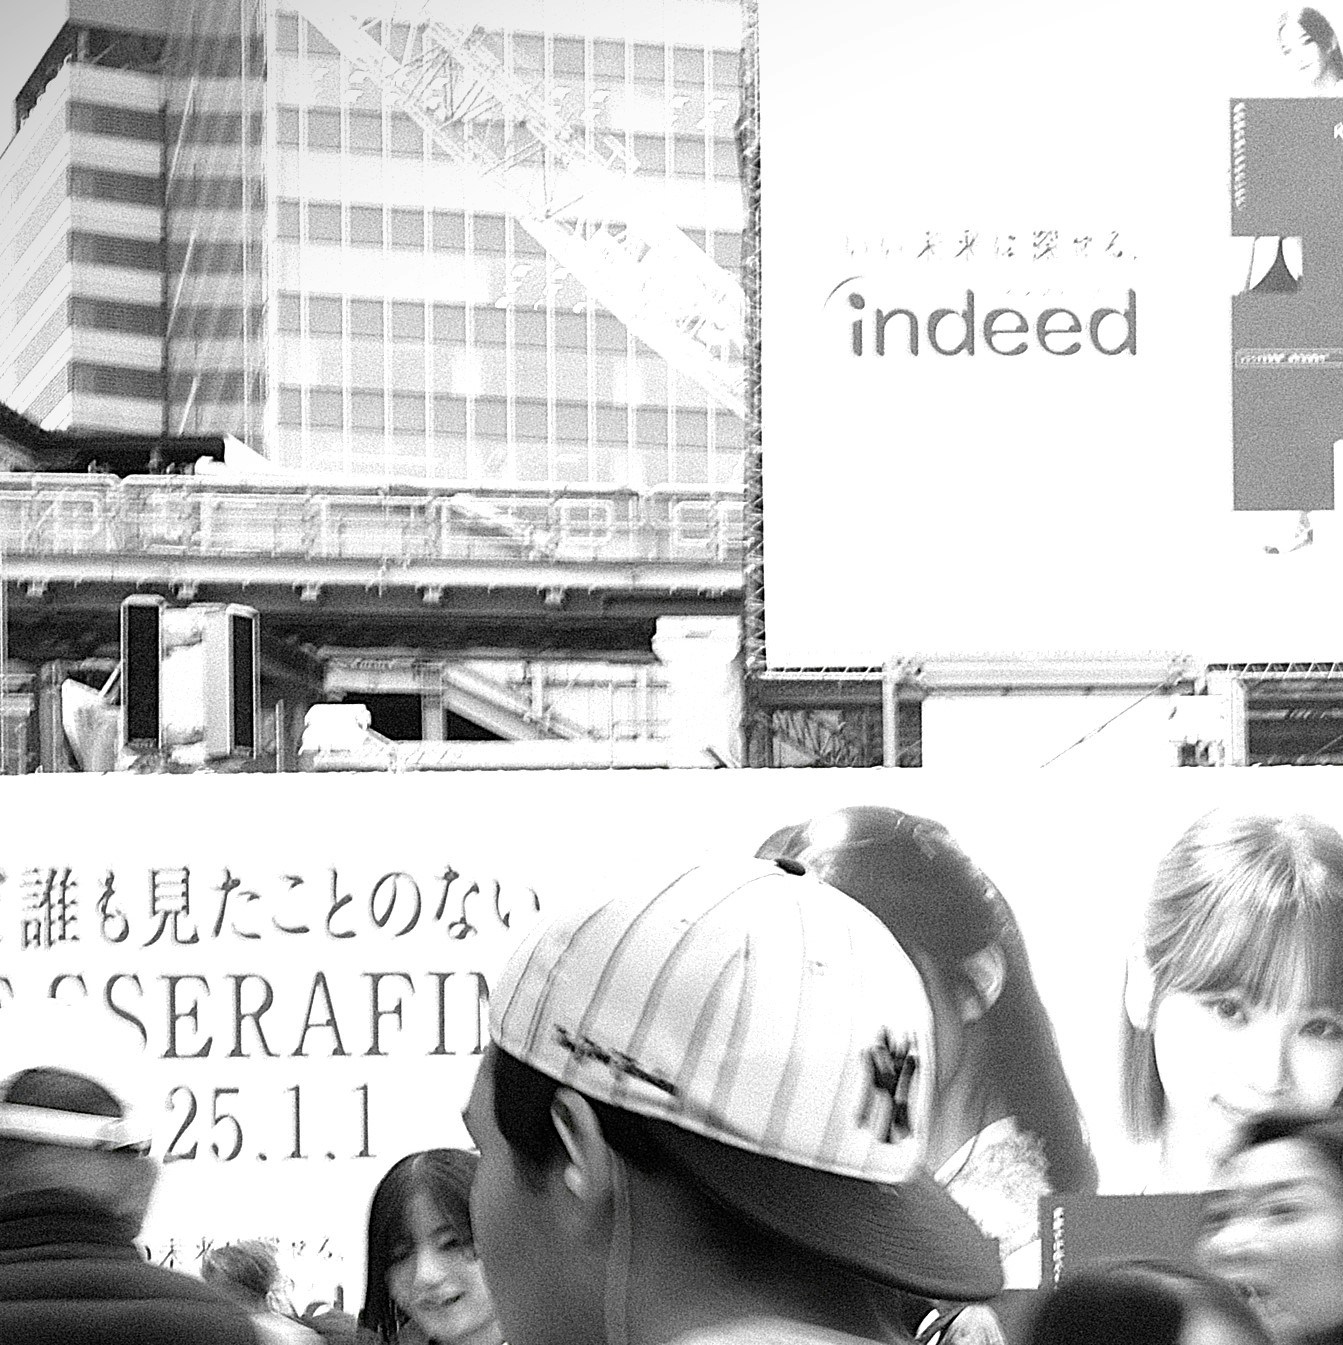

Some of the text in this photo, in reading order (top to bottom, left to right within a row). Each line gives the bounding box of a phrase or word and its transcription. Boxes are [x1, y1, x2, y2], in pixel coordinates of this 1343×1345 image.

[826, 277, 1137, 357] indeed
[0, 864, 542, 950] 誰も見たことのない
[48, 968, 490, 1059] SERAFI
